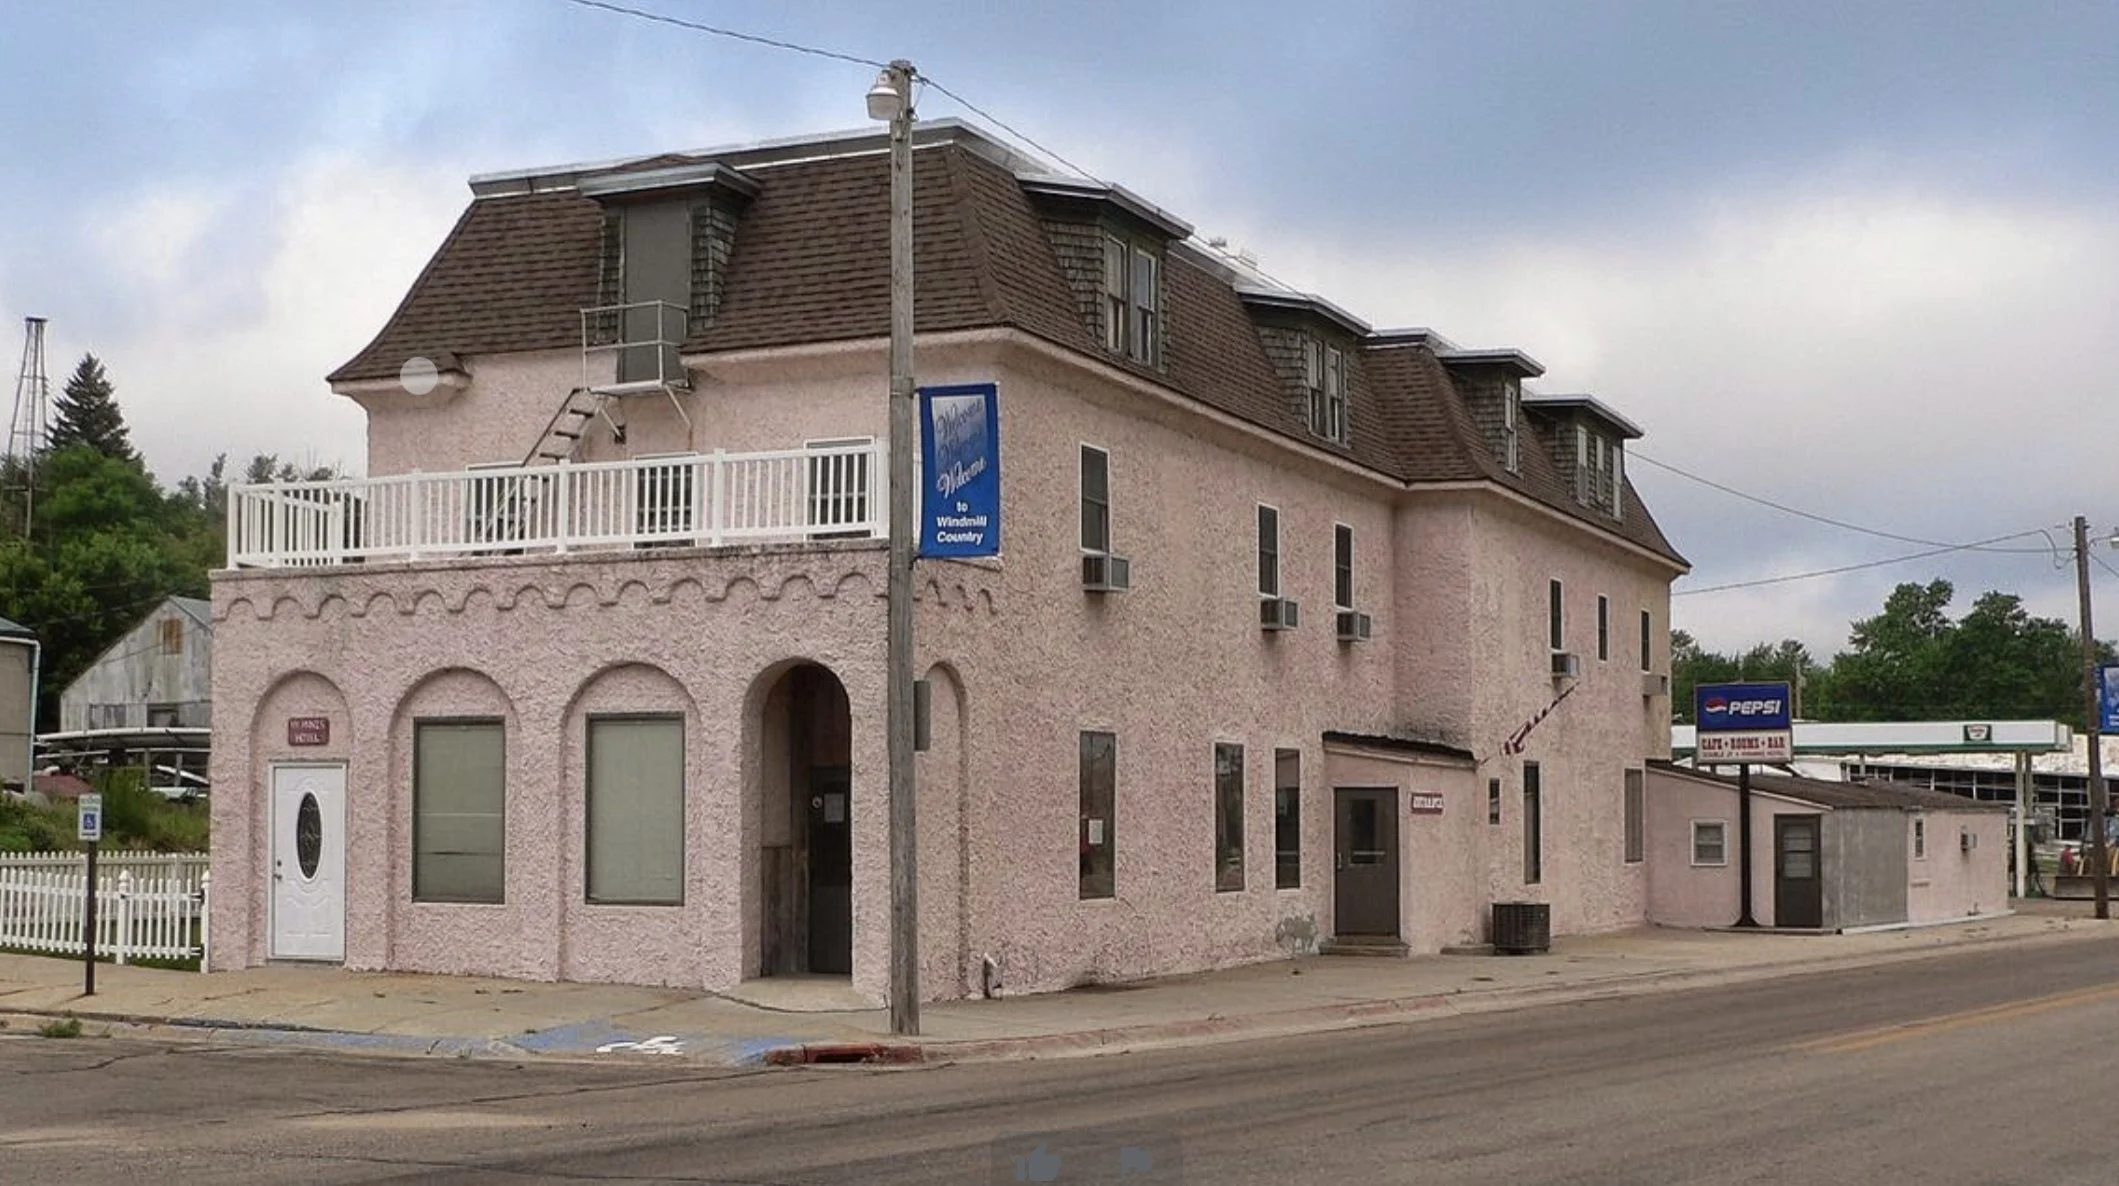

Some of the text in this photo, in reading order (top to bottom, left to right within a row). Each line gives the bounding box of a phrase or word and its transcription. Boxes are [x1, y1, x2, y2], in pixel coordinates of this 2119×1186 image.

[956, 502, 968, 513] to
[936, 515, 987, 528] Windmill
[937, 531, 983, 545] Country
[1728, 699, 1781, 715] PEPSI
[1702, 737, 1722, 750] CAFE
[1768, 735, 1785, 748] BAR
